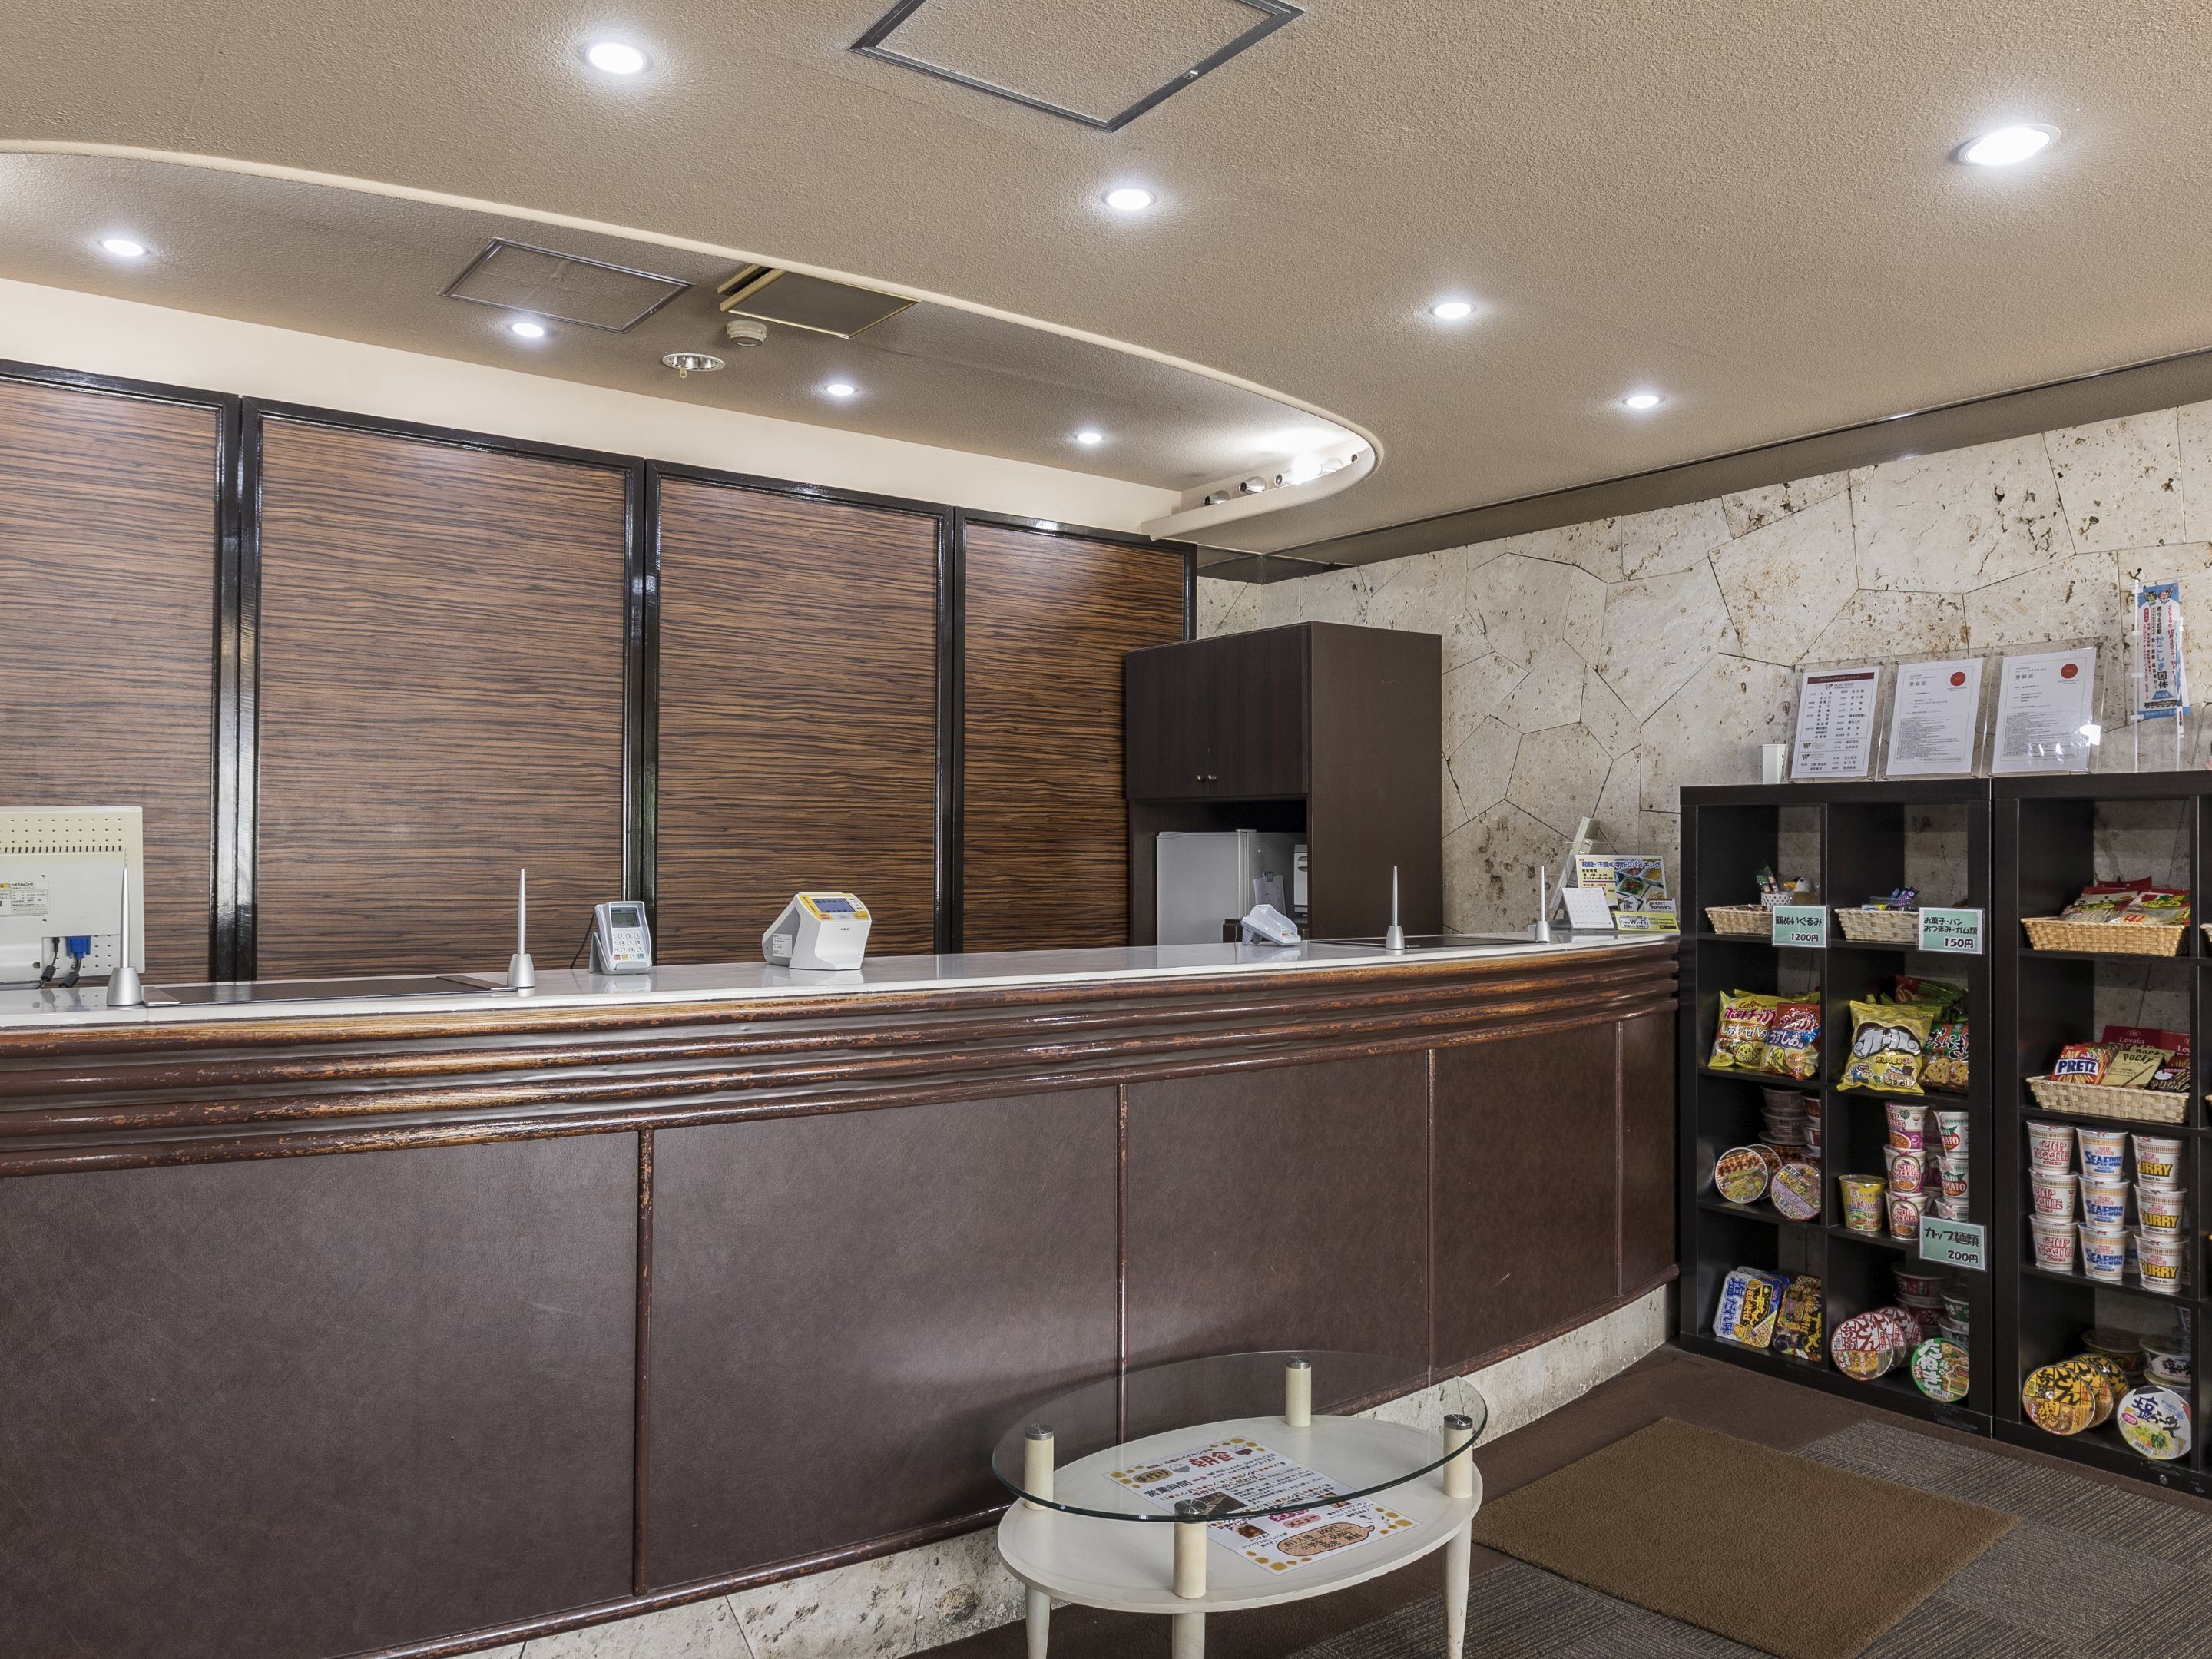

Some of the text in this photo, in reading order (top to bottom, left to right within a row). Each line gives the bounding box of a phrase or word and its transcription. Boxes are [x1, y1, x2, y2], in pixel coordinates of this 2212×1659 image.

[1775, 916, 1823, 926] 鶴ぬいぐるみ
[1923, 917, 1964, 926] お菓子・パン
[1923, 925, 1978, 935] おつまみ・ガム類
[1791, 933, 1819, 942] 1200円
[1945, 938, 1974, 948] 150円
[1853, 1028, 1921, 1059] カール
[2058, 1058, 2097, 1074] PRETZ
[2040, 1140, 2067, 1151] CUP
[2034, 1149, 2070, 1161] NOODLE
[2085, 1151, 2122, 1166] SEAFOOD
[2085, 1200, 2123, 1217] SEAFOOD
[1892, 1214, 1918, 1223] NOODLES
[2043, 1237, 2070, 1247] CUP
[1948, 1250, 1979, 1264] 200円
[2038, 1244, 2075, 1257] NOODLE
[2085, 1249, 2123, 1265] SEAFOOD
[1720, 1277, 1747, 1335] 塩だれ味
[1841, 1321, 1856, 1350] 兵衛
[1856, 1320, 1880, 1352] どん
[1917, 1339, 1942, 1391] たぬき
[2054, 1368, 2081, 1406] どん
[1188, 1451, 1235, 1468] 朝食
[1135, 1469, 1170, 1483] 手作り
[1144, 1479, 1194, 1498] 営業時間
[1285, 1515, 1318, 1528] メニュー
